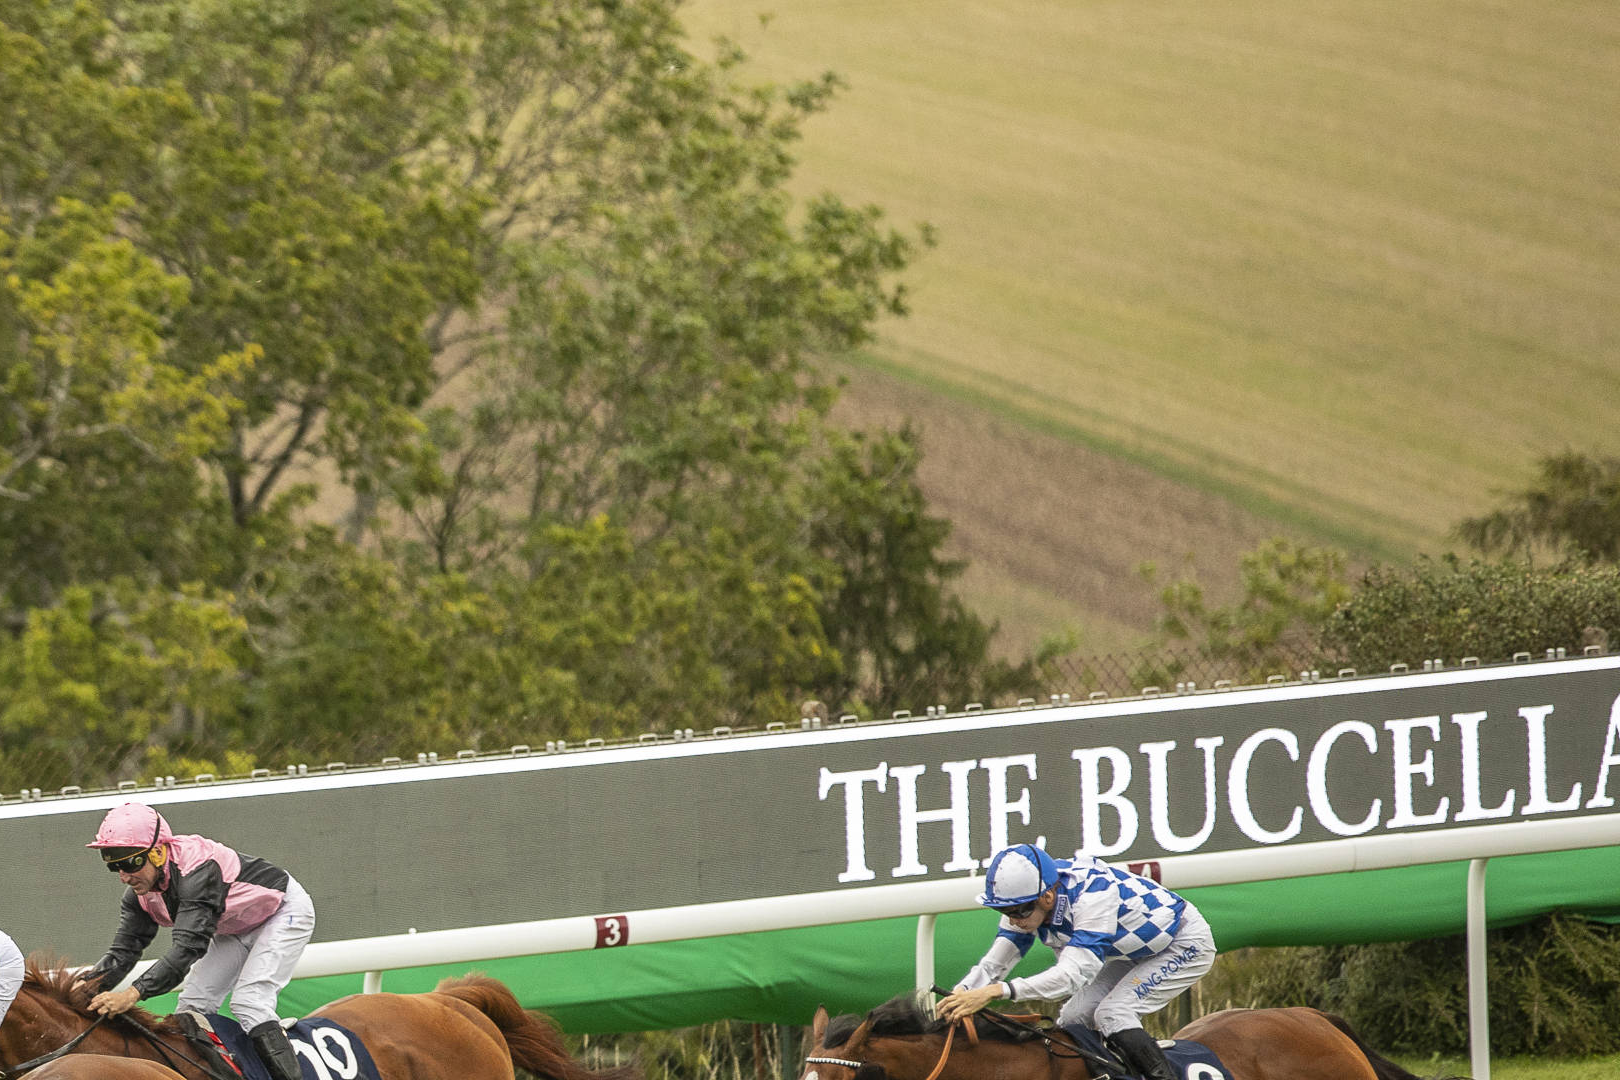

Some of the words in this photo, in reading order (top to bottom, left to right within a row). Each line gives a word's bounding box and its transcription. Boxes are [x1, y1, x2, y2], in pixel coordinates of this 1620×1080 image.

[818, 752, 1046, 884] THE
[604, 918, 621, 946] 3
[1132, 972, 1163, 999] KING
[1160, 945, 1200, 977] POWER
